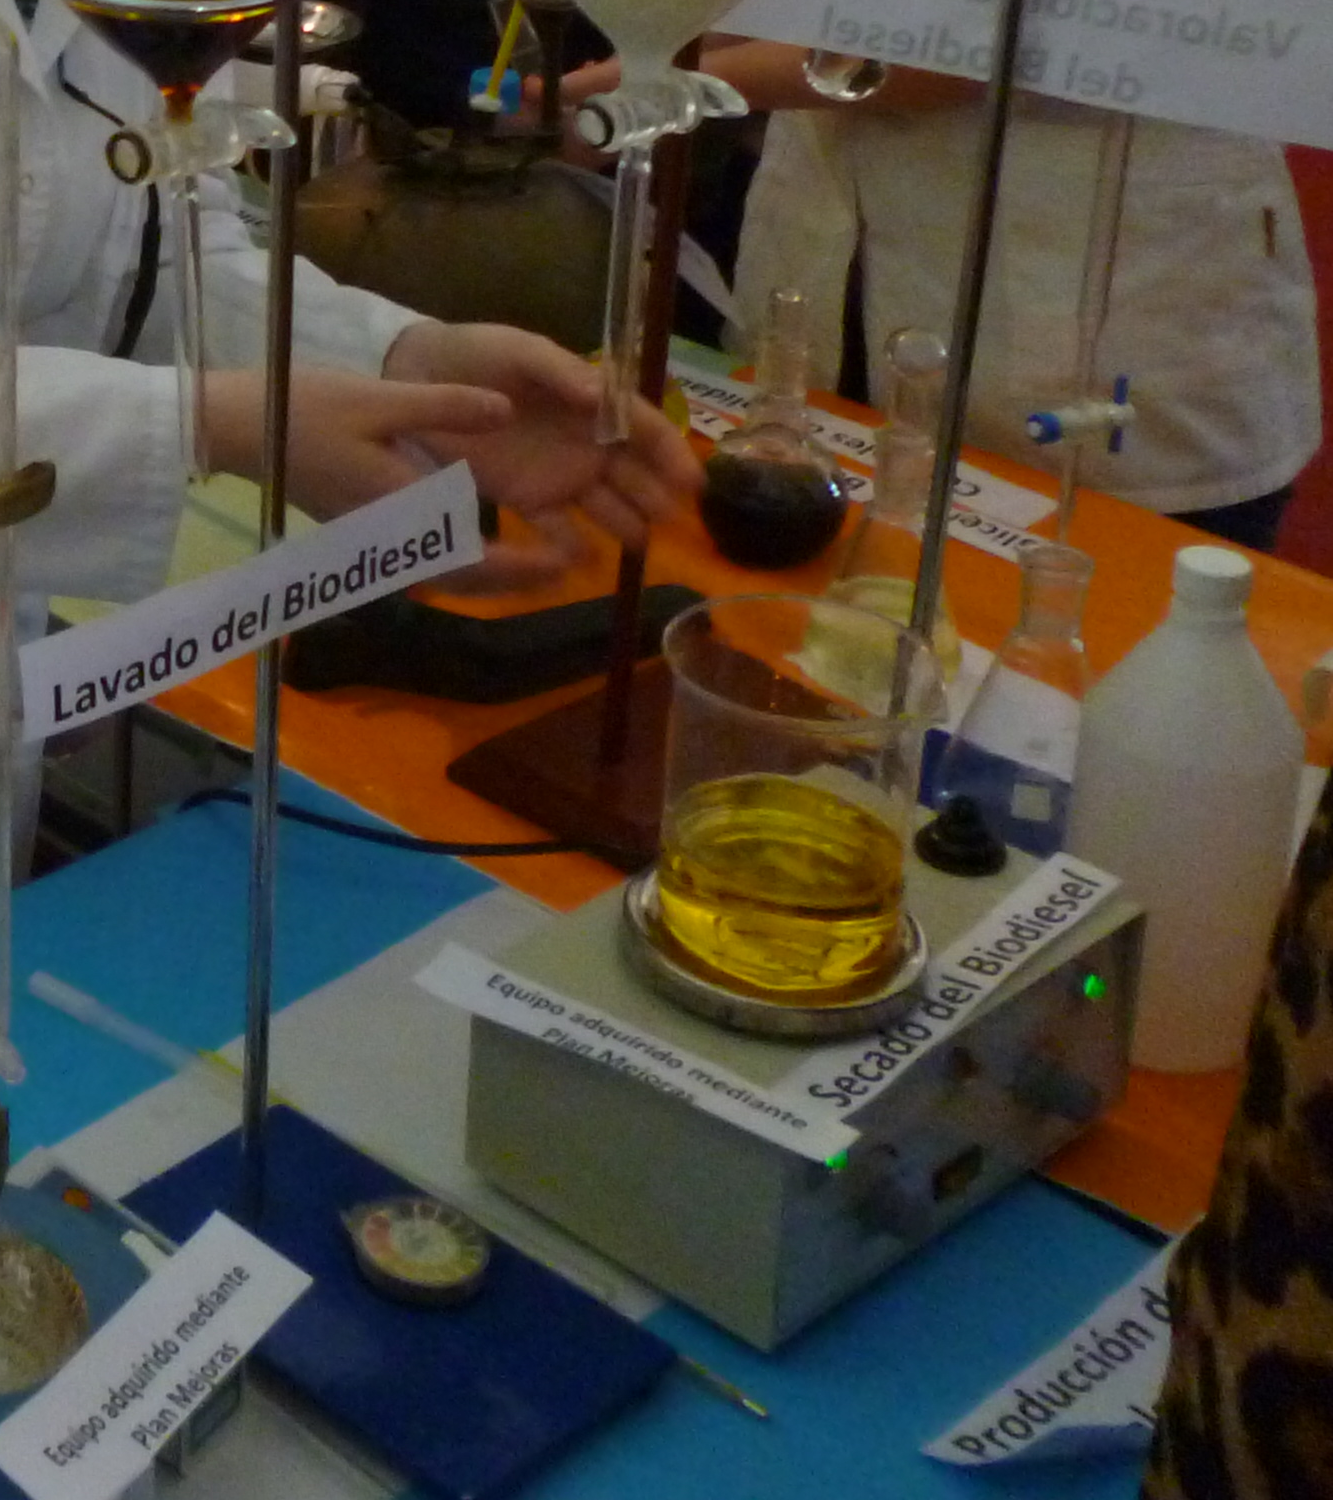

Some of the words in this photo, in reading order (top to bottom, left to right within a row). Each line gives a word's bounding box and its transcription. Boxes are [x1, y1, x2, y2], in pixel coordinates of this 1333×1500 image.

[52, 636, 198, 724] Lavado
[211, 593, 270, 654] del
[282, 511, 455, 622] Biodiesel
[486, 972, 566, 1017] Equipo
[568, 1009, 683, 1070] adquirido
[687, 1066, 809, 1132] mediante
[808, 1021, 933, 1108] Secado
[926, 974, 983, 1021] del
[958, 867, 1102, 978] Biodiesel
[42, 1414, 107, 1467] Equipo
[100, 1338, 181, 1419] adquirido
[175, 1265, 251, 1343] mediante
[130, 1407, 178, 1451] Plan
[165, 1340, 240, 1411] Mejoras
[951, 1317, 1156, 1456] Producción
